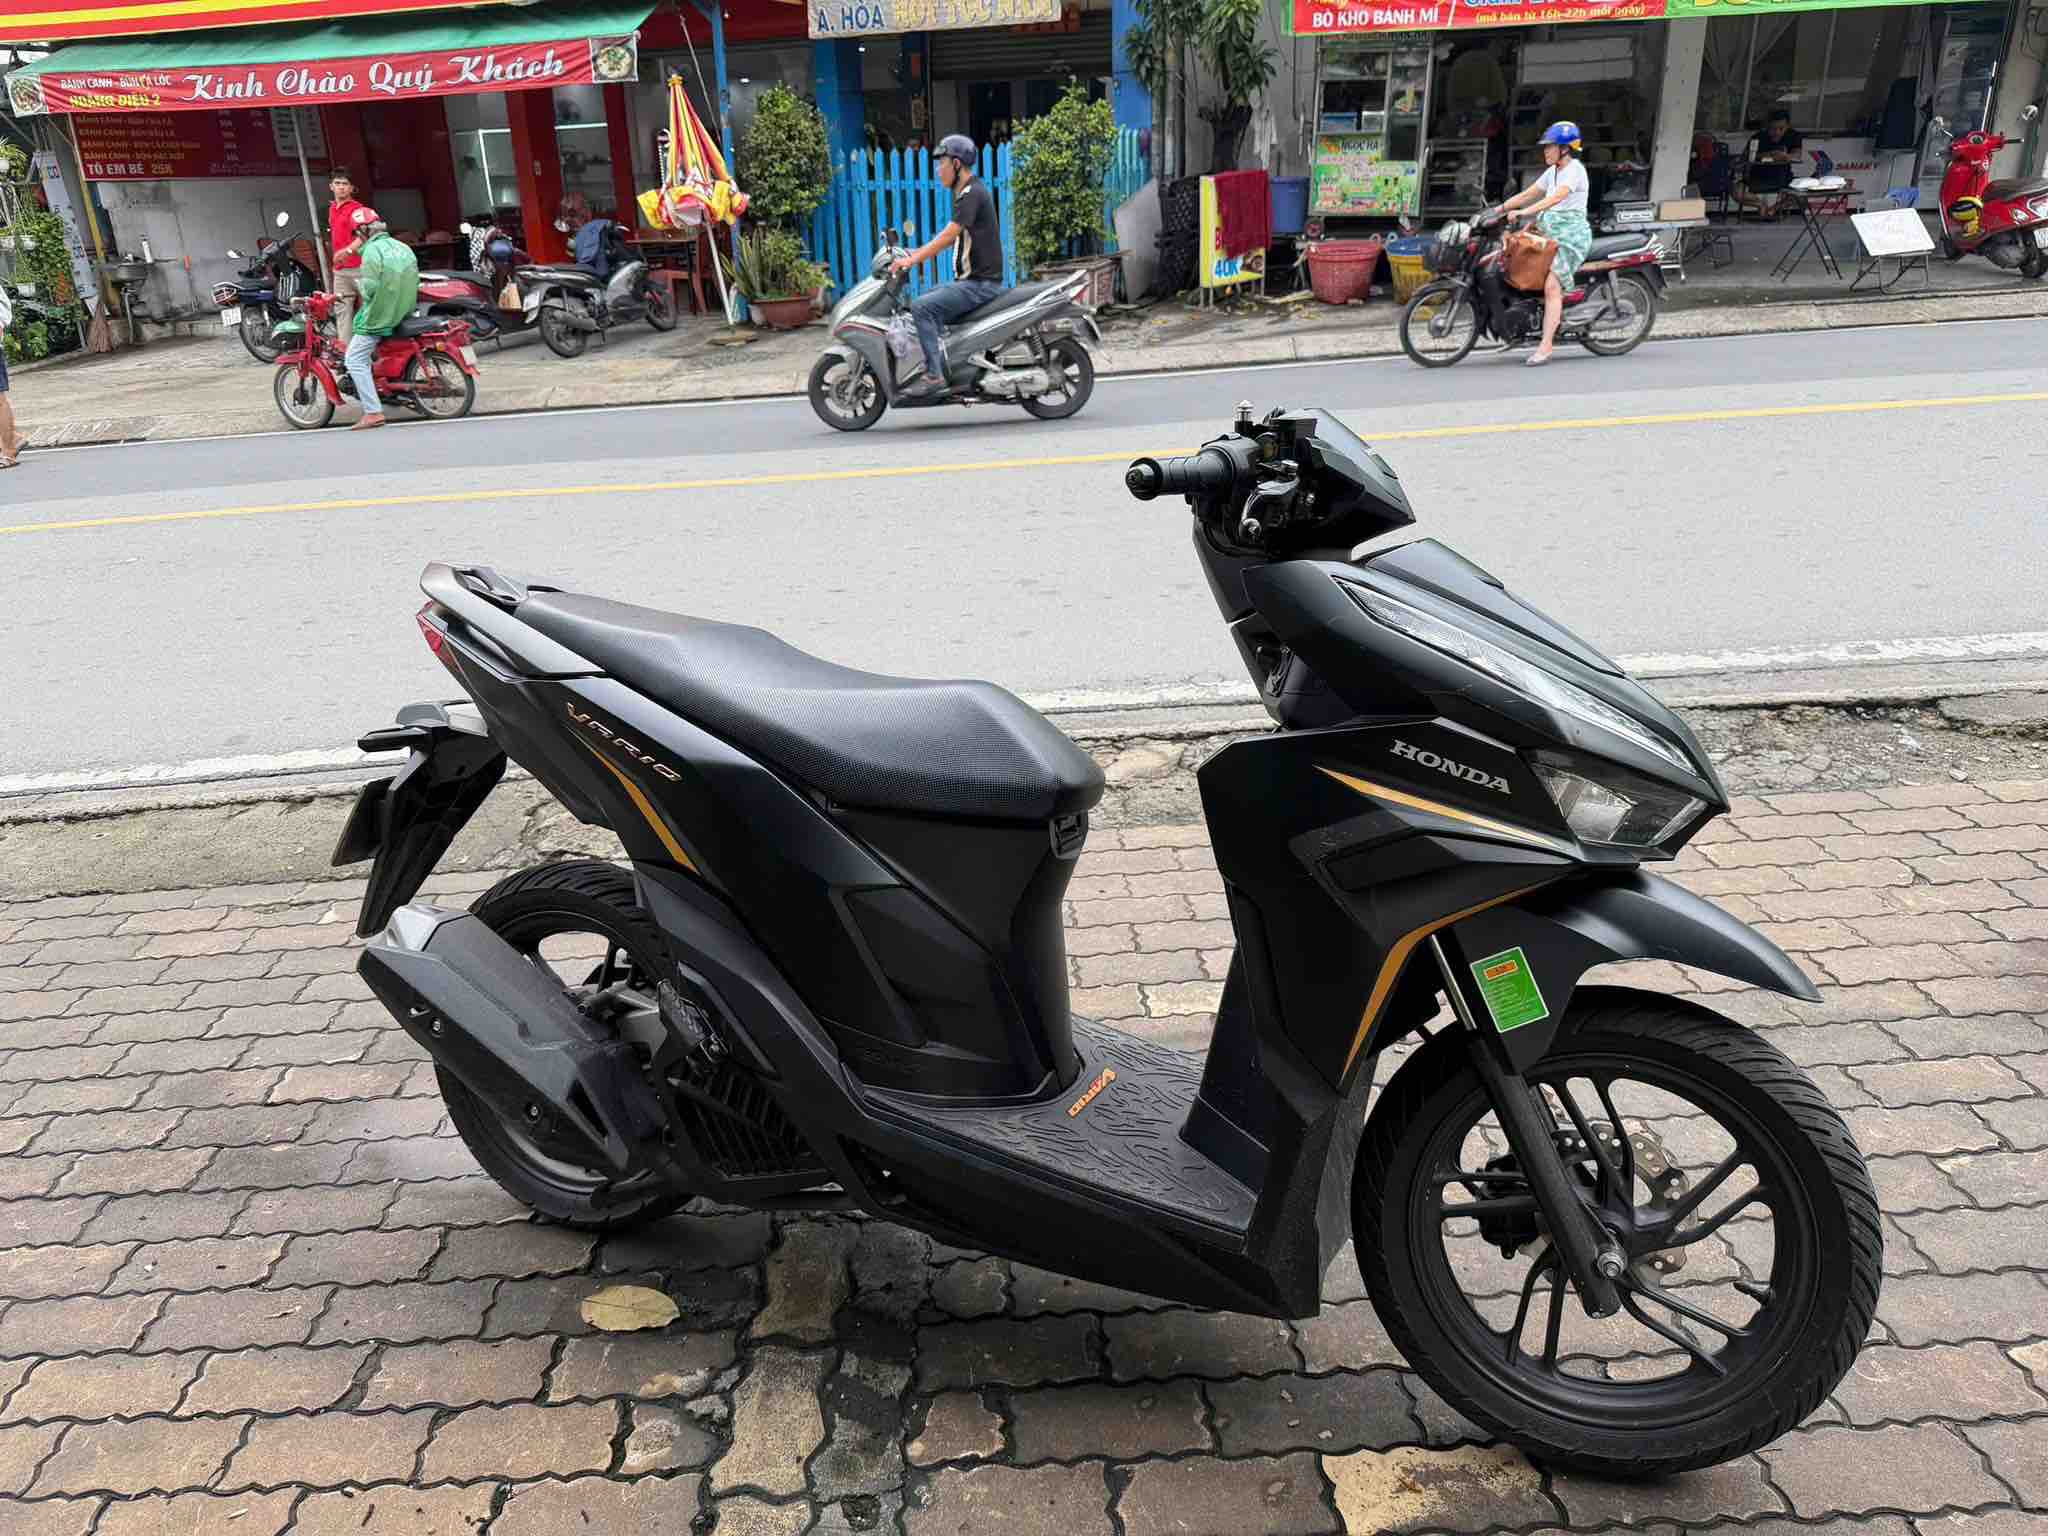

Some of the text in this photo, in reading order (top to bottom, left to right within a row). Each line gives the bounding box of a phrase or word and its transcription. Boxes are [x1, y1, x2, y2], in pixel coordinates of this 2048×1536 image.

[1337, 11, 1369, 26] KHO
[1373, 7, 1414, 25] BÁNH
[180, 50, 566, 101] Kinh Chào Quý Khách
[1390, 739, 1512, 794] HONDA
